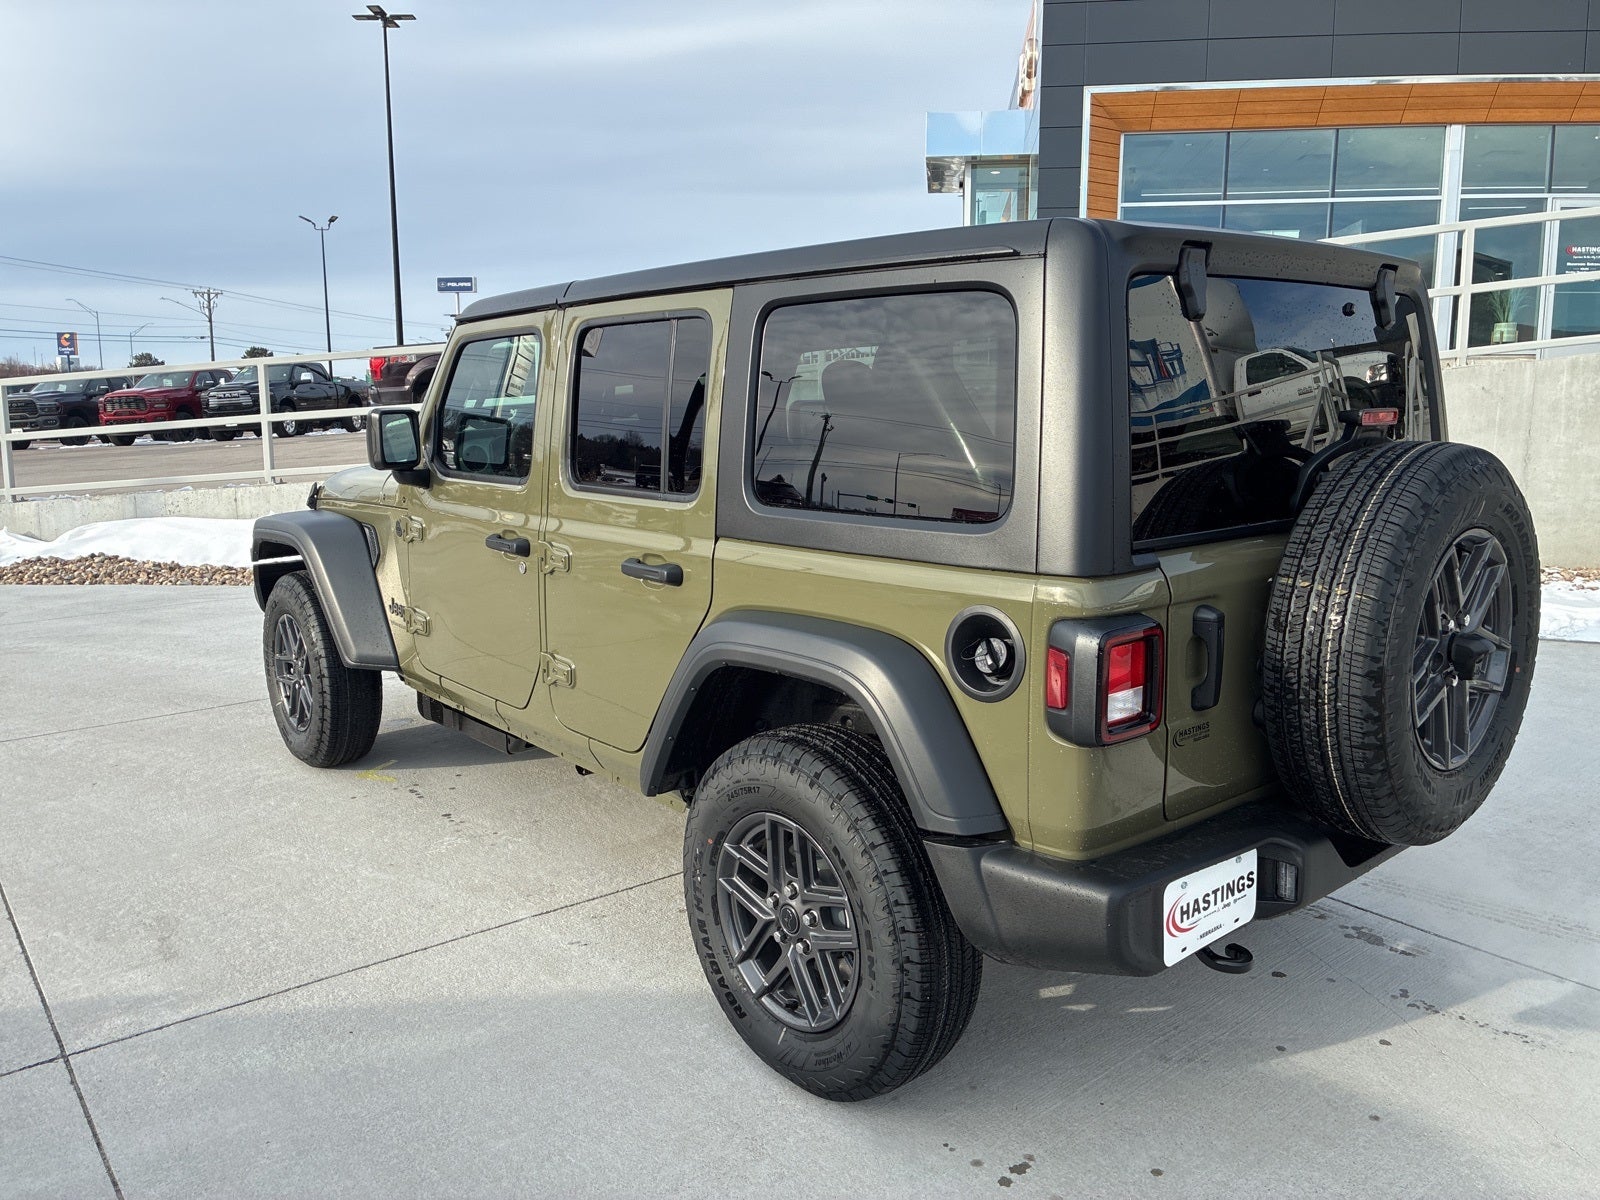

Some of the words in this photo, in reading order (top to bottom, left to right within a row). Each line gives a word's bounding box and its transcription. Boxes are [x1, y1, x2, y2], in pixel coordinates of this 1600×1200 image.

[1178, 721, 1210, 738] HASTINGS
[726, 786, 760, 802] 245/75R17
[1180, 870, 1255, 924] HASTINGS
[697, 918, 747, 1019] ROADIAN
